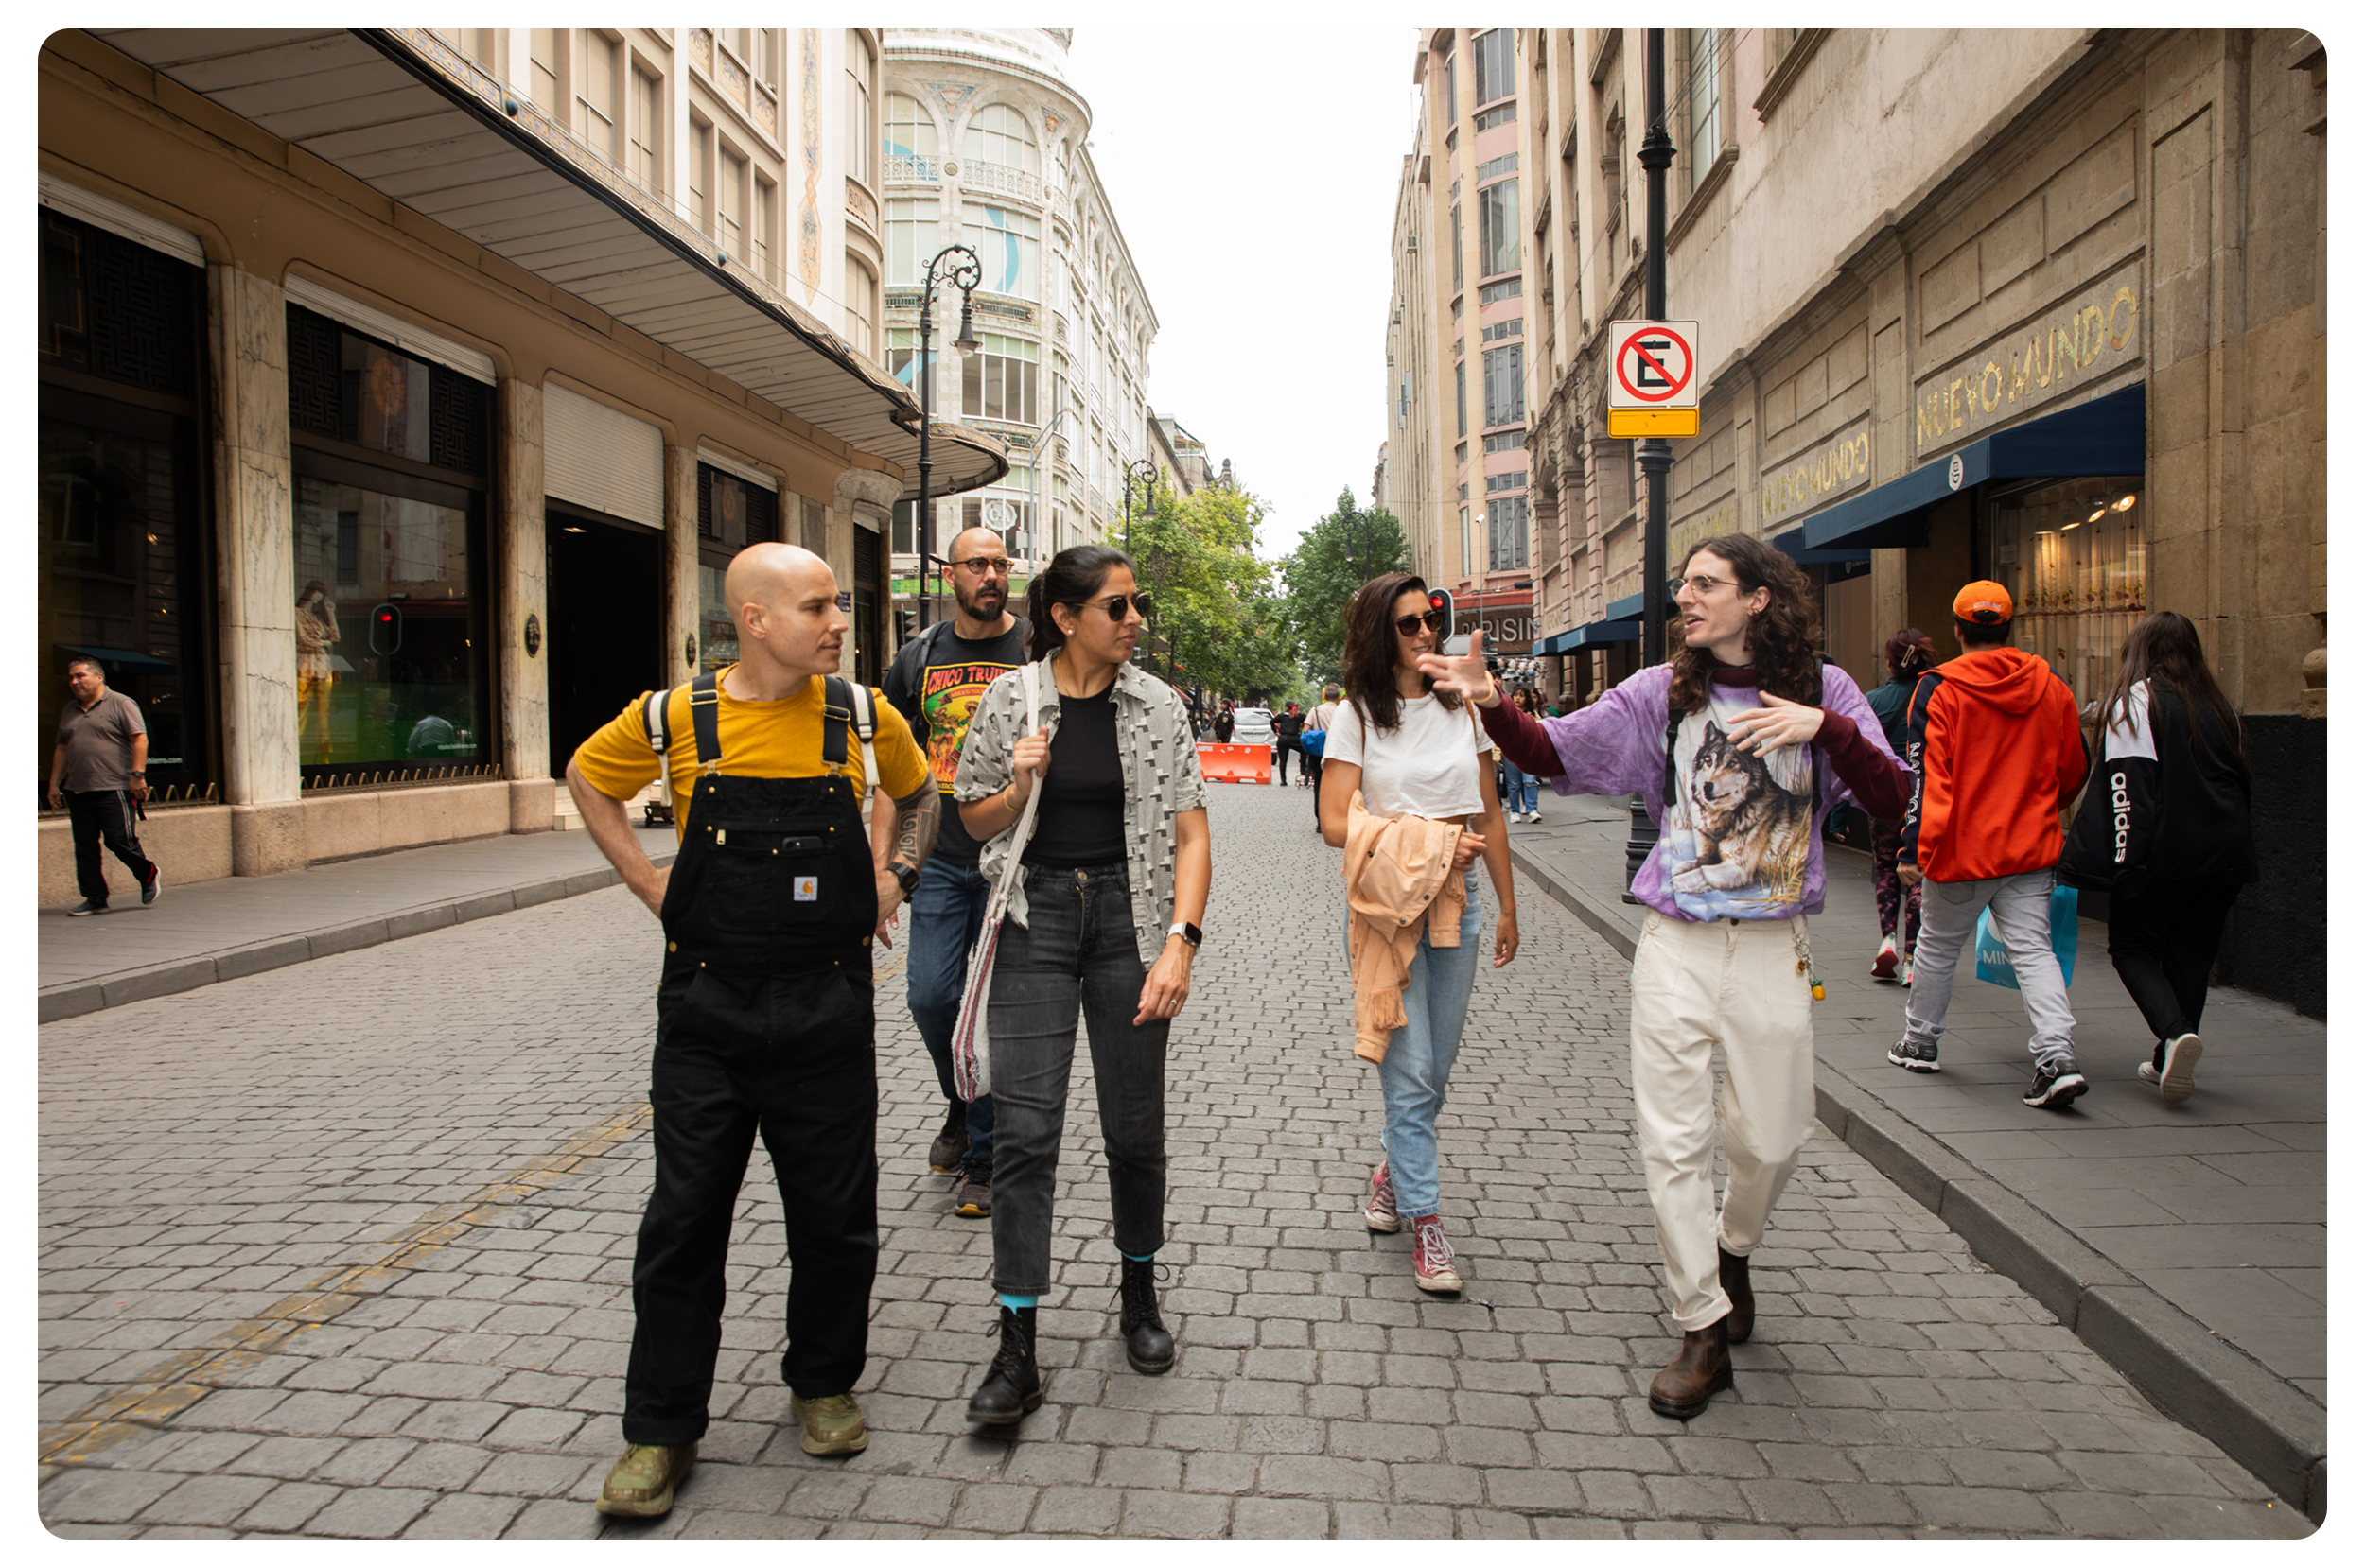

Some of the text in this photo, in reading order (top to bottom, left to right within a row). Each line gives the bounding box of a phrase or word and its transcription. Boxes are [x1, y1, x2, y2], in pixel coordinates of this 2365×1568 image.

[1638, 340, 1672, 388] E
[1917, 286, 2138, 446] NUEVO MUNDO
[1762, 431, 1869, 521] NUEVO MUNDO
[927, 668, 964, 696] CHICO
[2111, 772, 2132, 862] adidas
